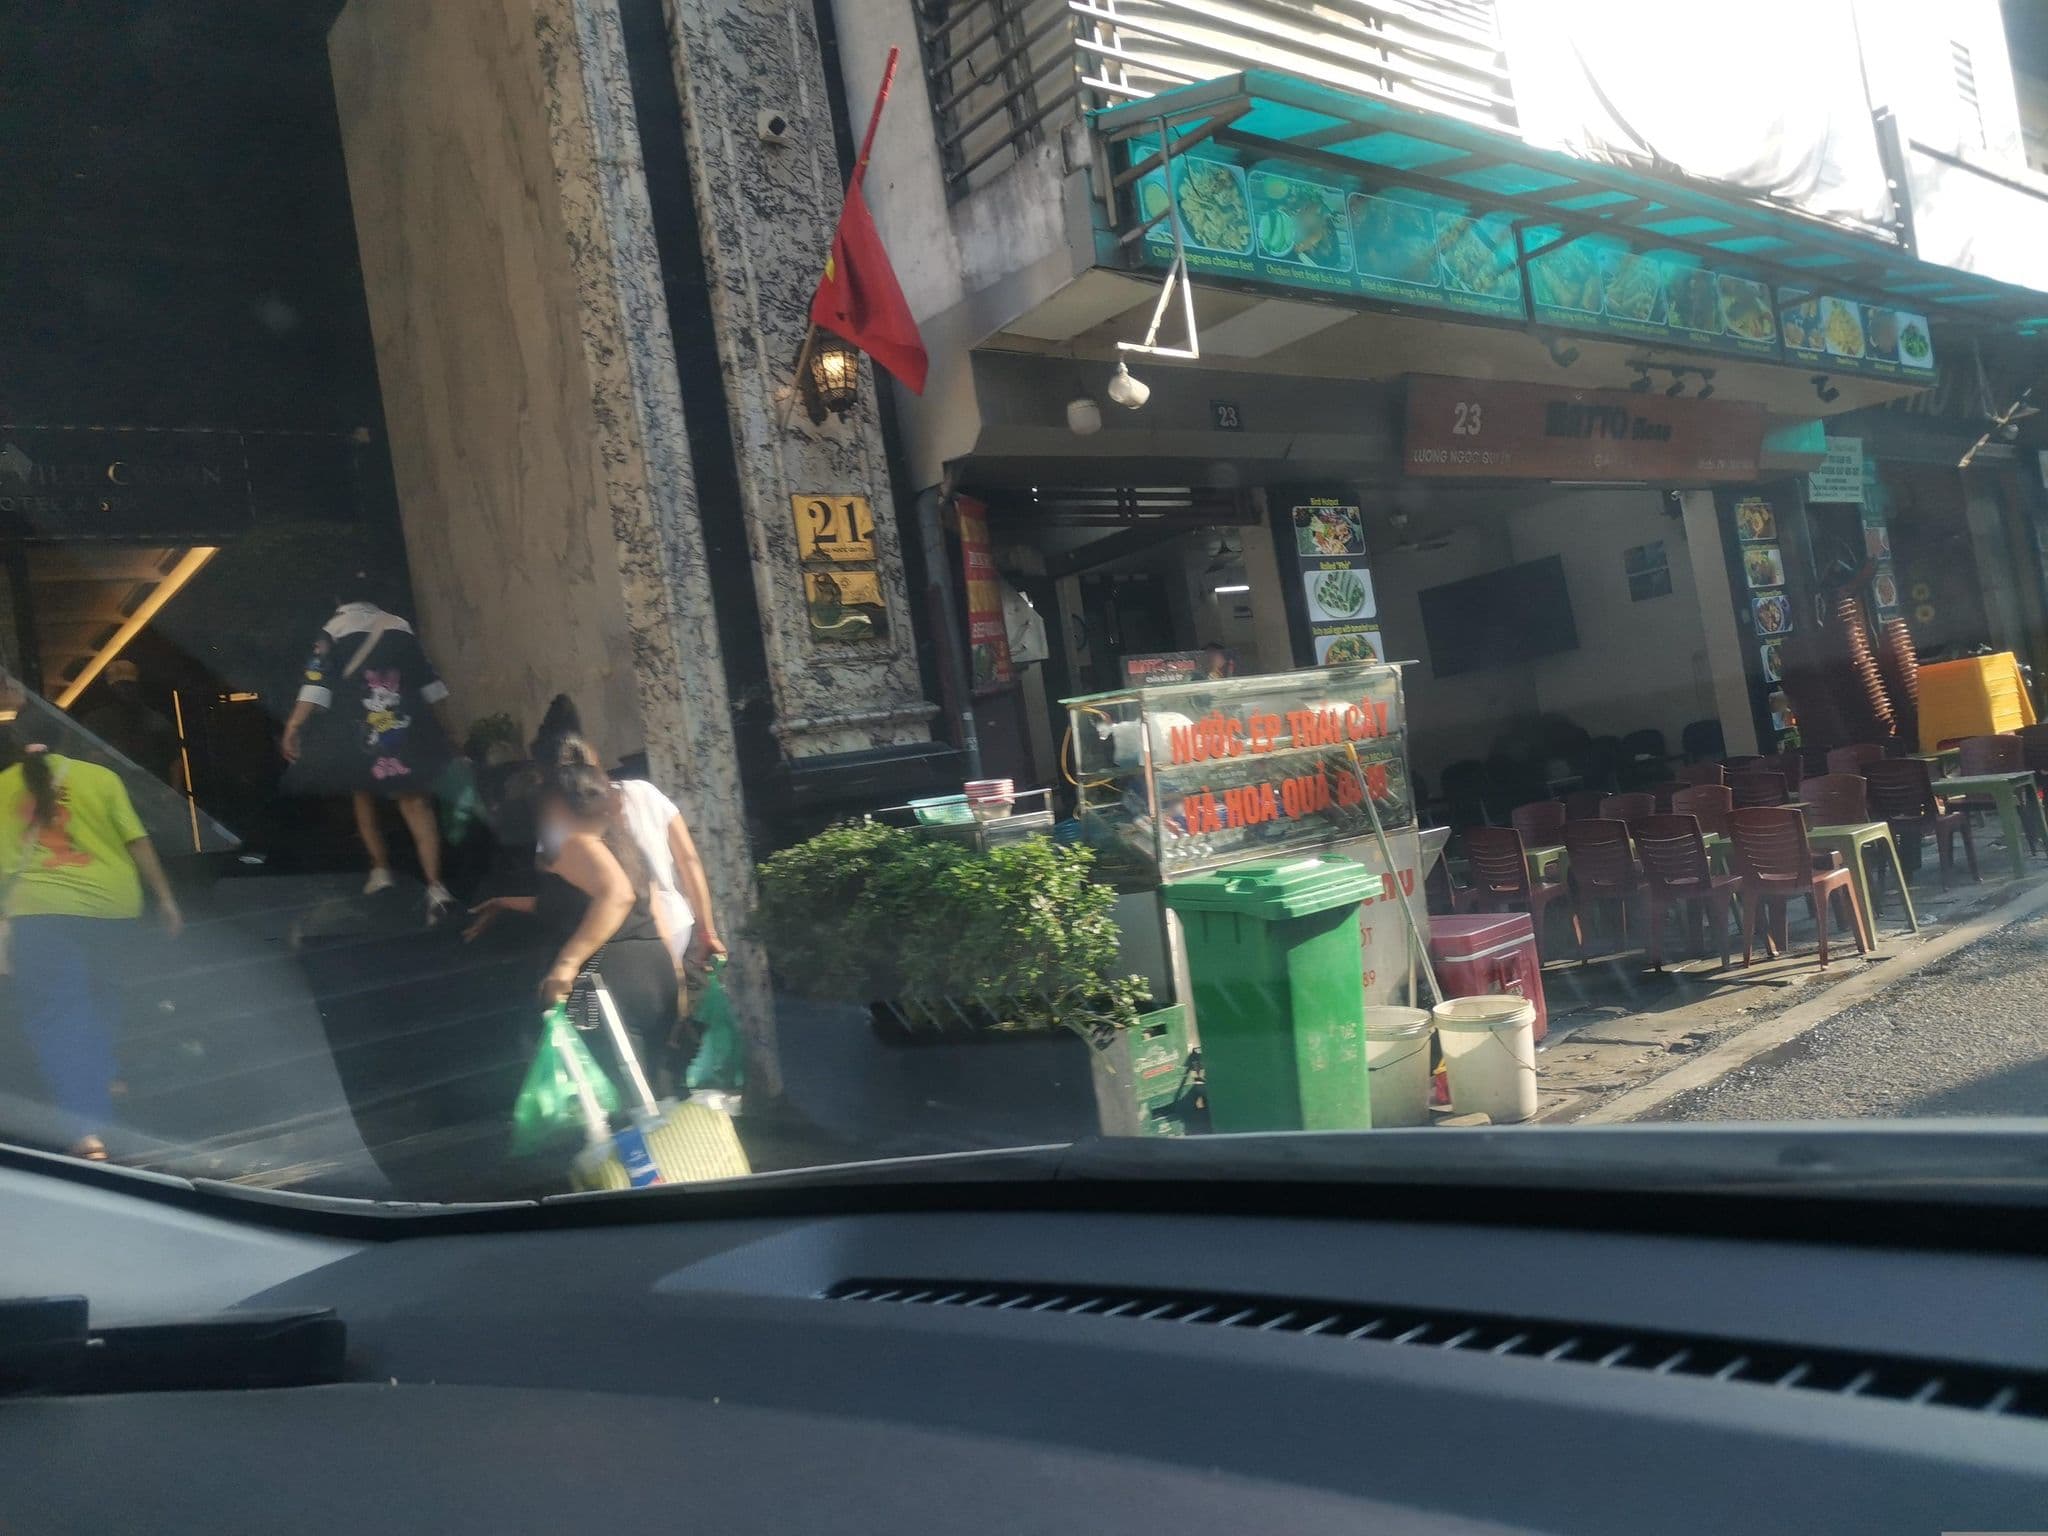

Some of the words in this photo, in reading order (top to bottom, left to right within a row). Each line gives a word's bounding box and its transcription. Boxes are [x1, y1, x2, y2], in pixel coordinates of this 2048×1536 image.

[1218, 406, 1238, 427] 23
[1453, 401, 1482, 436] 23
[807, 500, 867, 544] 21
[1170, 708, 1244, 766] NƯỚC
[1248, 706, 1282, 754] ÉP
[1345, 695, 1388, 742] CÂY
[1183, 785, 1222, 836] VÀ
[1223, 782, 1279, 828] HOA
